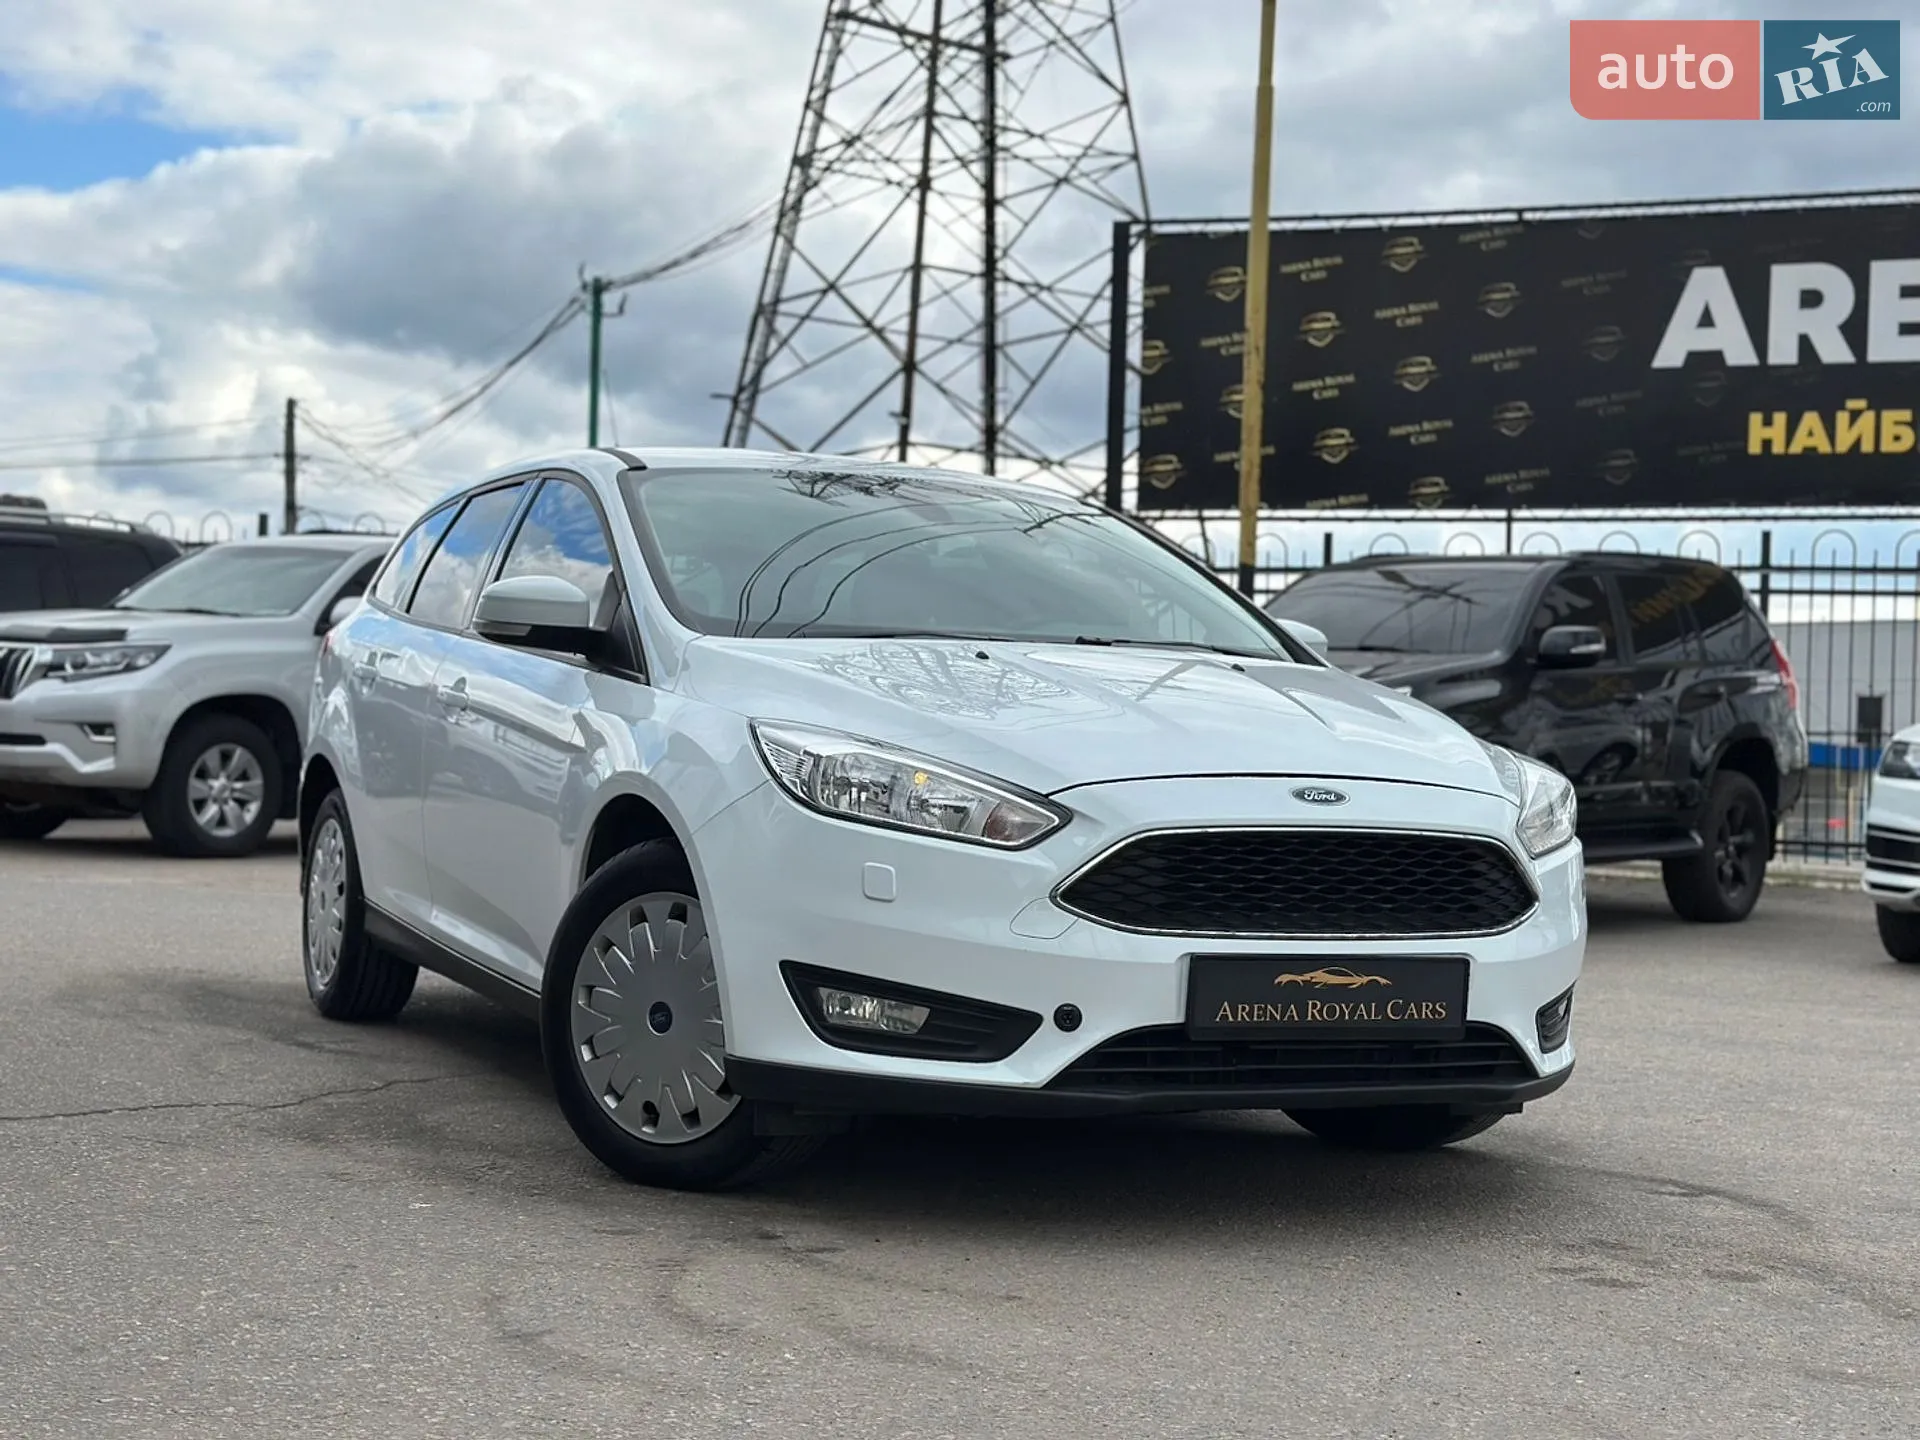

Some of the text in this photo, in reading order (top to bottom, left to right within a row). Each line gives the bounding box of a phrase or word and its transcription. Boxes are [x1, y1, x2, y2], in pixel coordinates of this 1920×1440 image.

[1651, 258, 1920, 368] ARE
[1747, 398, 1916, 455] НАЙБ
[1303, 789, 1337, 801] Ford
[1215, 998, 1447, 1022] ARENA ROYAL CARS
